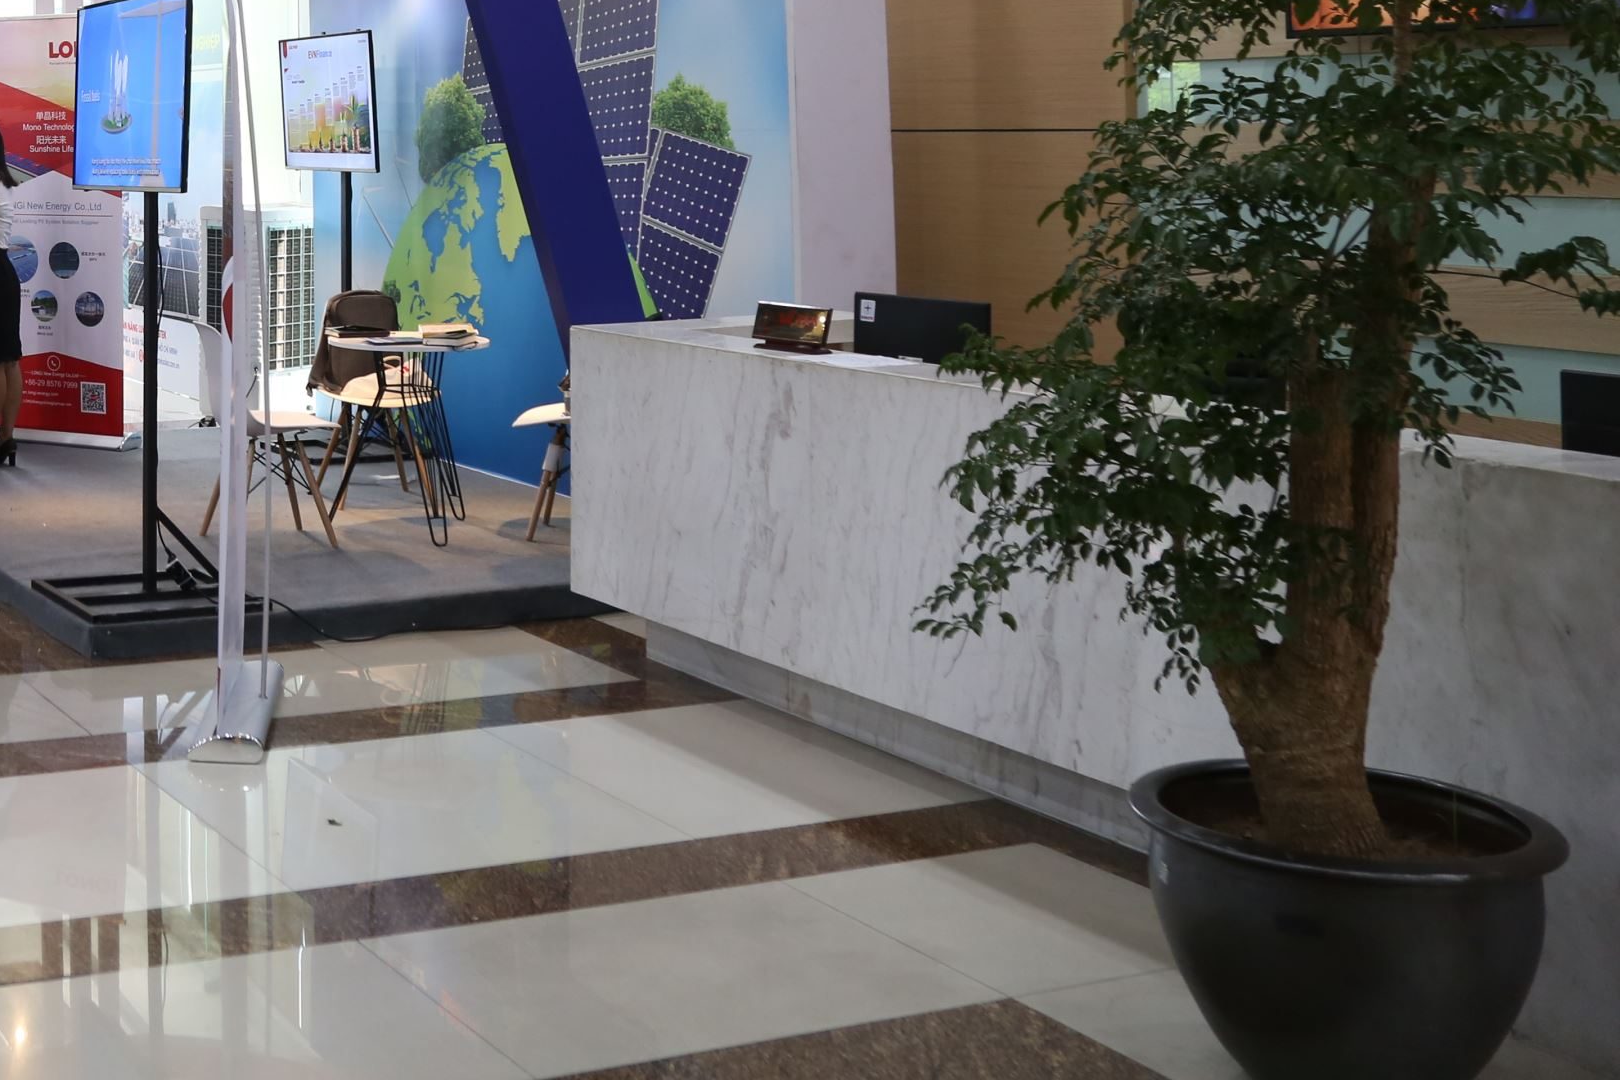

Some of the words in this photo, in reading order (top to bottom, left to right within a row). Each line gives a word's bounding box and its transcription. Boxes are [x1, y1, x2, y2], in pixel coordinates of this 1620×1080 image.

[48, 40, 77, 58] LO
[36, 112, 66, 120] 单晶科技
[36, 136, 66, 144] 阳光未来
[46, 202, 70, 212] Energy
